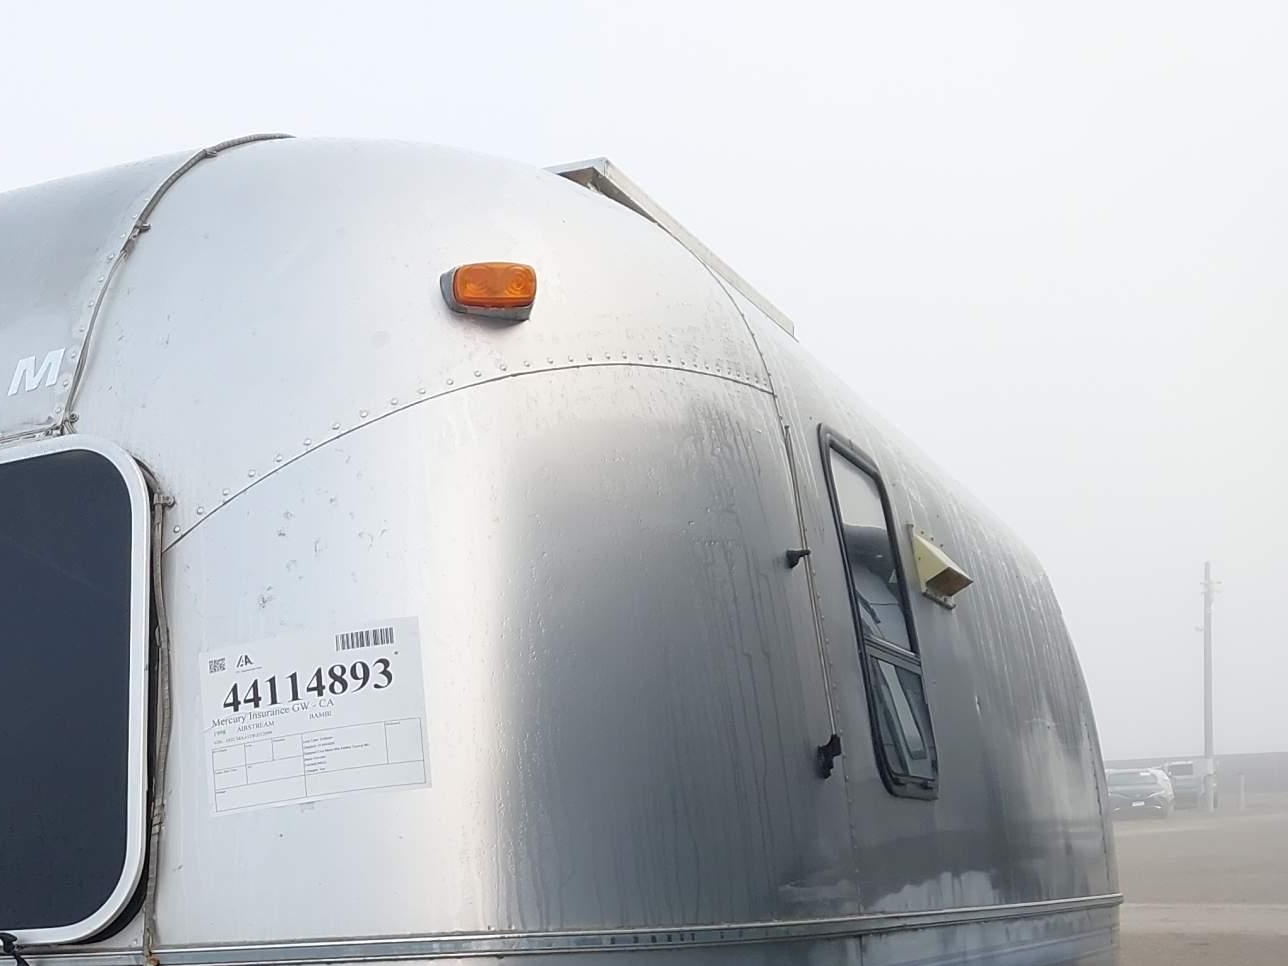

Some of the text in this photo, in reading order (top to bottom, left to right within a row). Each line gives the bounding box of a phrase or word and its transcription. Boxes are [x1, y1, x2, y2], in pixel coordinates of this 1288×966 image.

[223, 657, 393, 713] 44114893
[211, 713, 247, 729] Mercury
[249, 705, 290, 721] Insurance
[292, 701, 310, 713] GW
[319, 698, 335, 709] CA
[237, 720, 275, 732] AIRSTREAM
